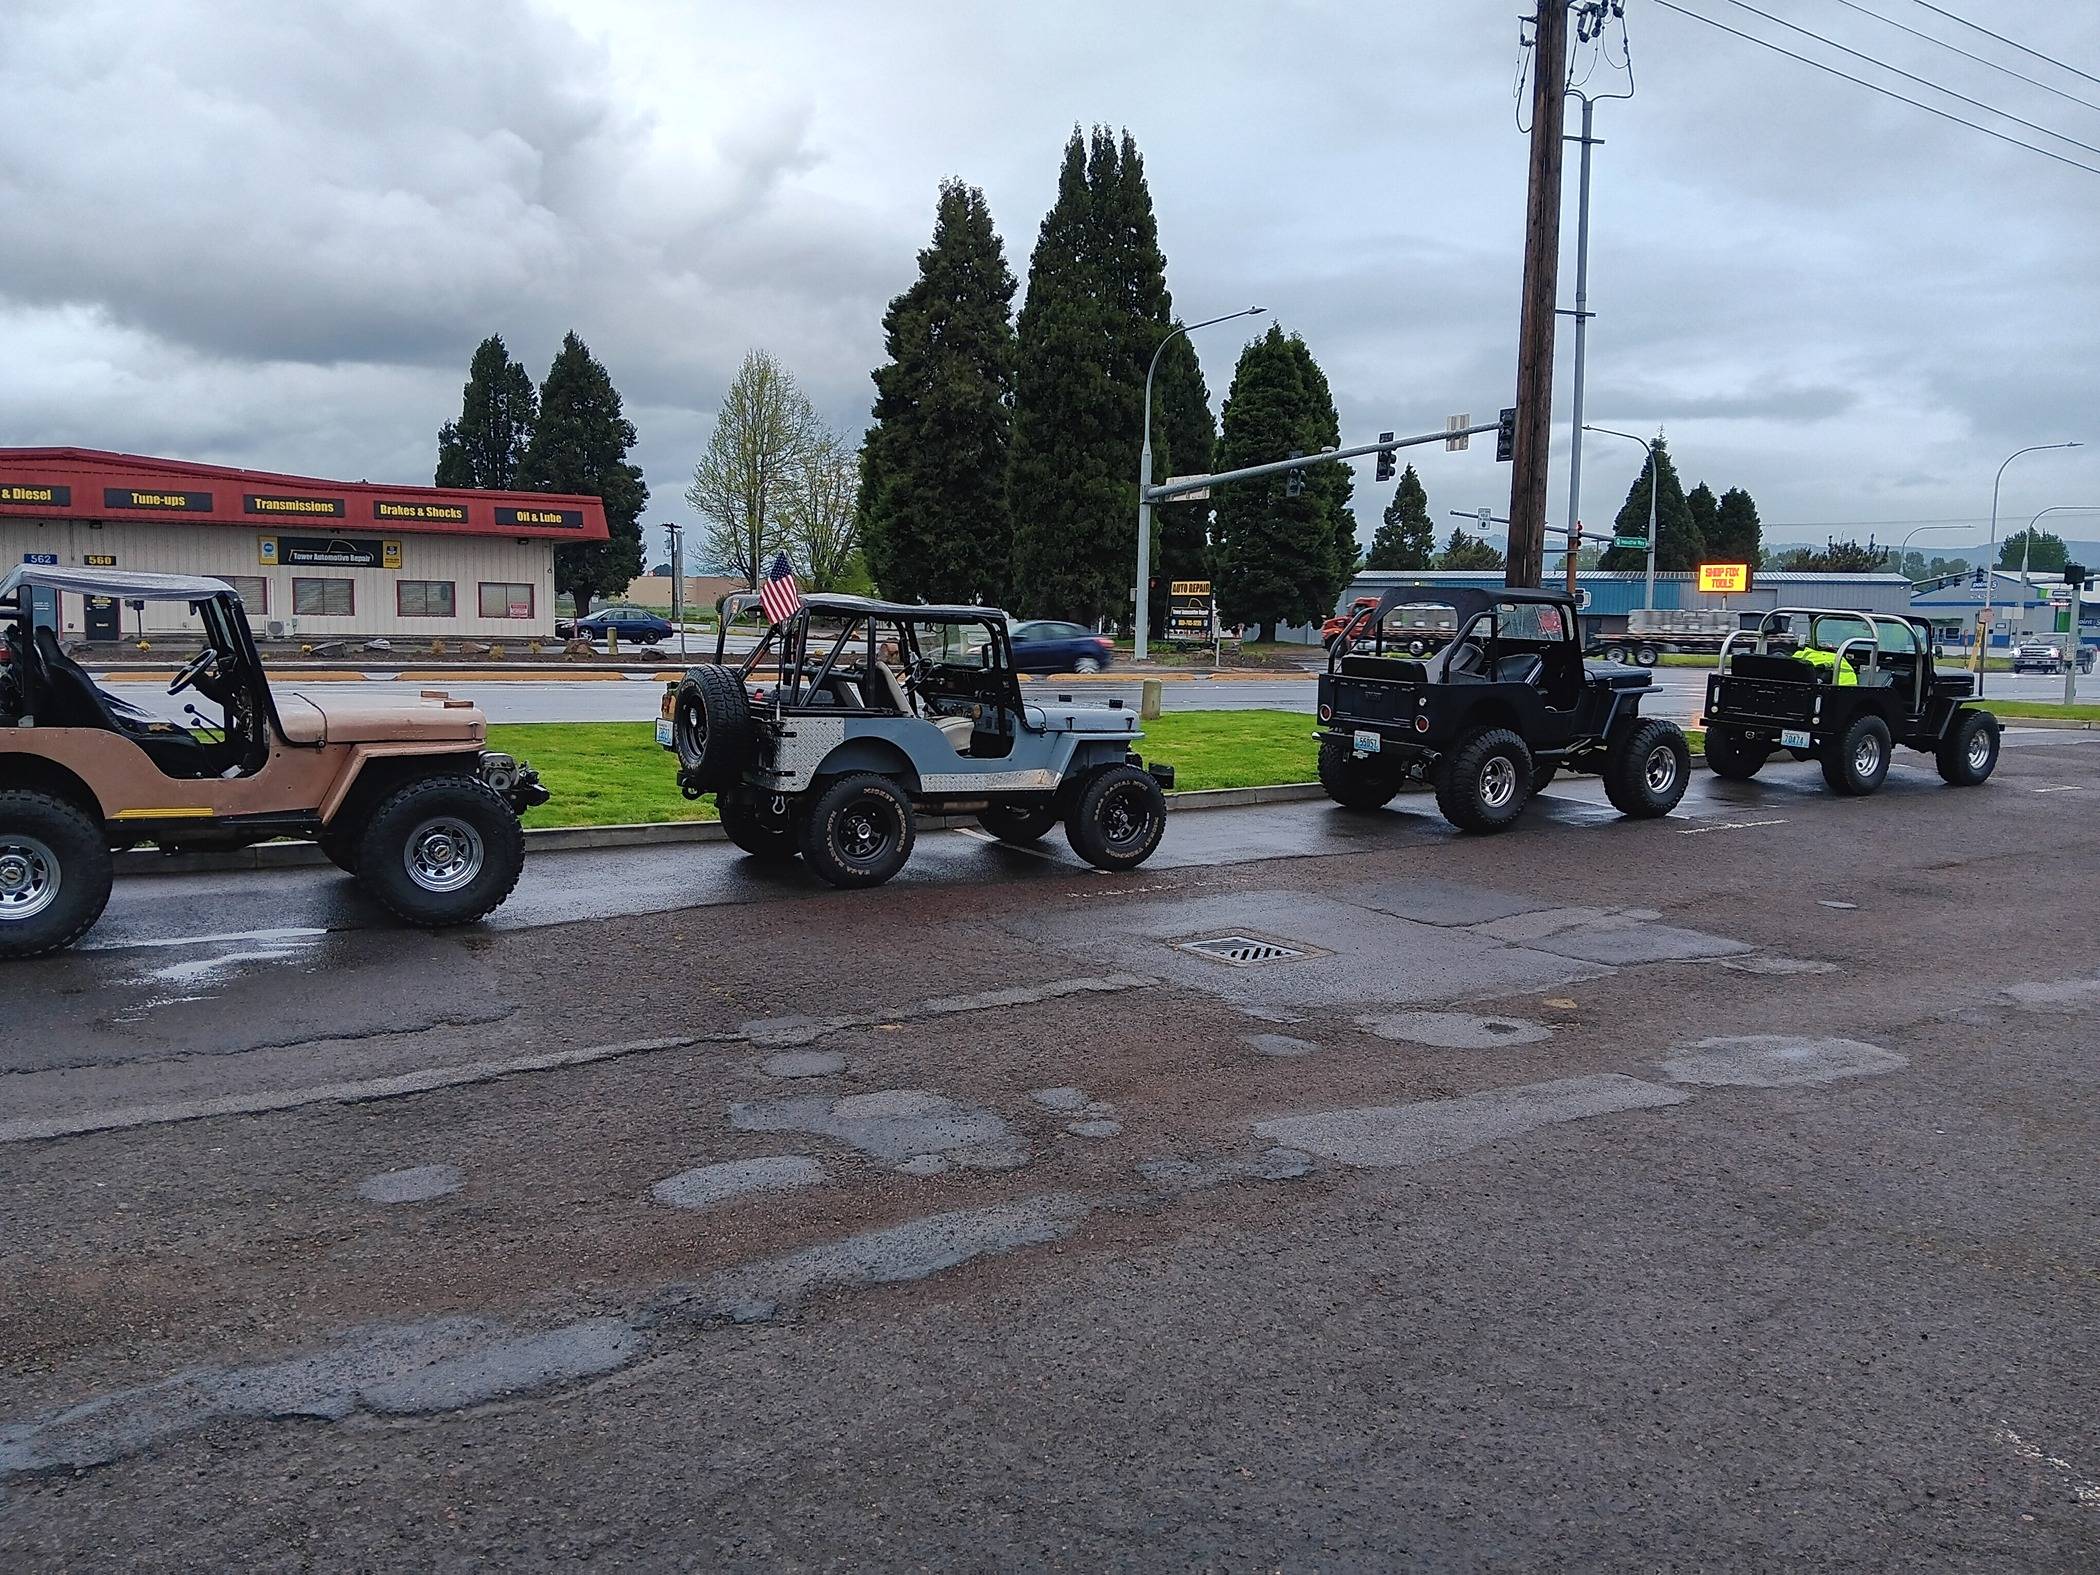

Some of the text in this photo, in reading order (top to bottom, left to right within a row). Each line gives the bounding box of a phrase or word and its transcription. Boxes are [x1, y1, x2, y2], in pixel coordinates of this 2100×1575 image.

[2, 488, 52, 500] & Diesel
[131, 492, 186, 506] Tune-ups
[254, 498, 334, 512] Transmissions
[380, 504, 462, 518] Brakes & Shocks
[516, 511, 562, 523] Oil & Lube
[30, 554, 51, 564] 562
[314, 553, 350, 562] Automotive
[1706, 568, 1740, 577] SHOP FOX
[1172, 583, 1210, 593] AUTO REPAIR
[1712, 578, 1734, 588] TOOLS
